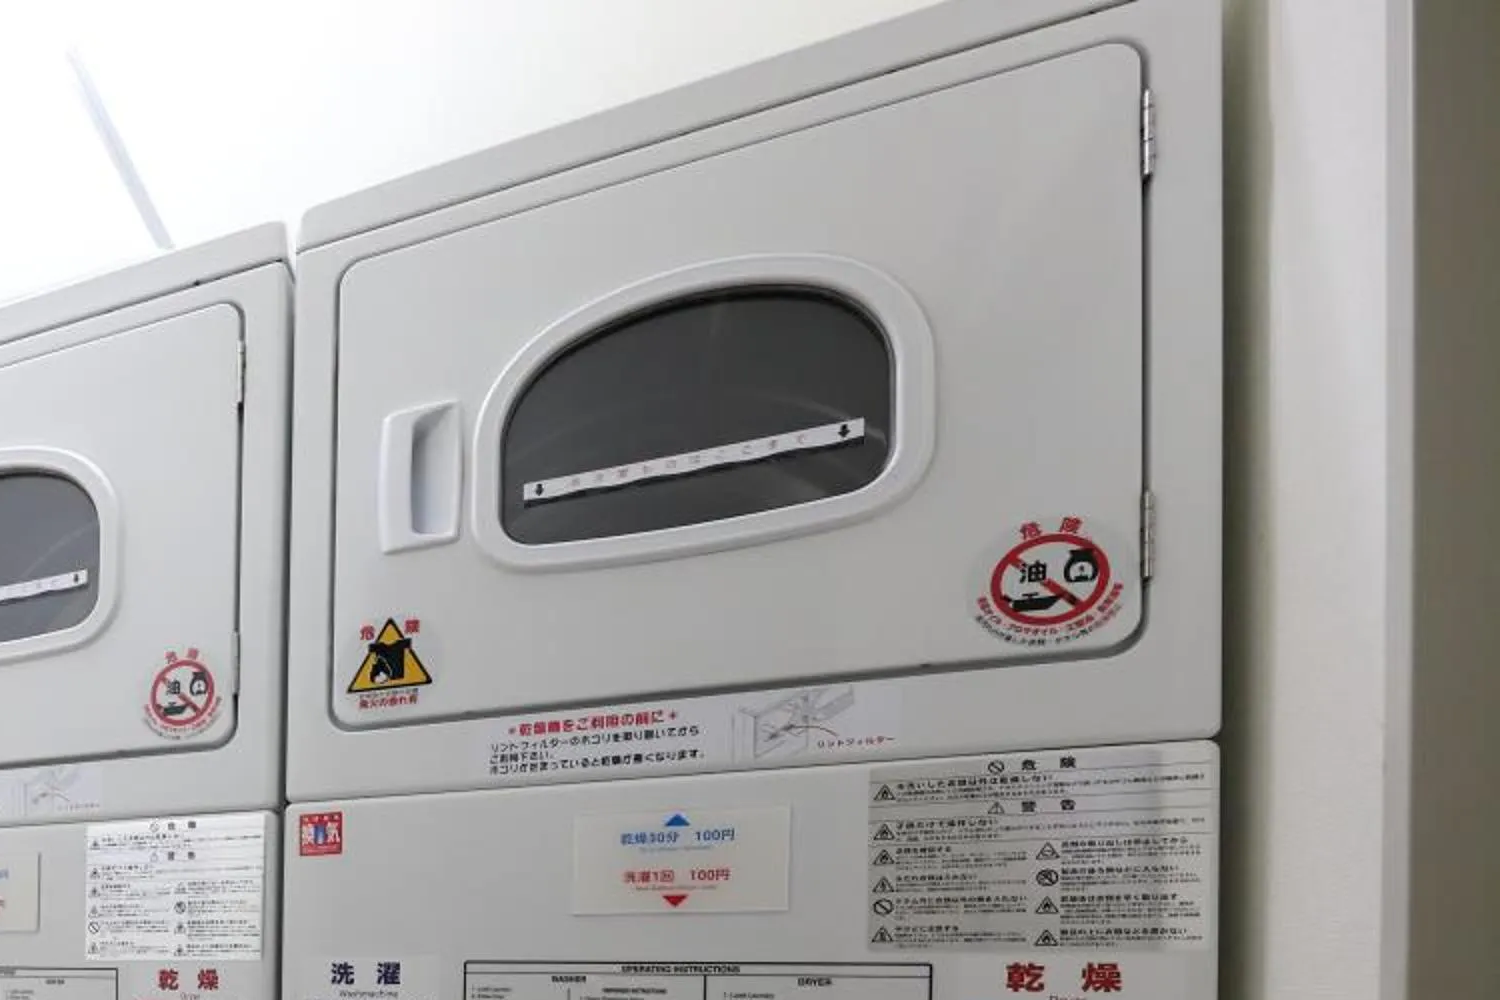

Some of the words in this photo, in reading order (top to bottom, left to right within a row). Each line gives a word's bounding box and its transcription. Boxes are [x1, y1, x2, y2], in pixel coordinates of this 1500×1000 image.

[1019, 560, 1047, 583] 油
[620, 831, 680, 846] 乾燥30分
[695, 828, 736, 842] 100円
[623, 869, 675, 884] 洗濯1回
[689, 866, 731, 881] 100円
[158, 968, 219, 990] 乾燥
[331, 962, 401, 985] 洗濯
[797, 977, 833, 987] DRYER
[1006, 962, 1122, 993] 乾燥
